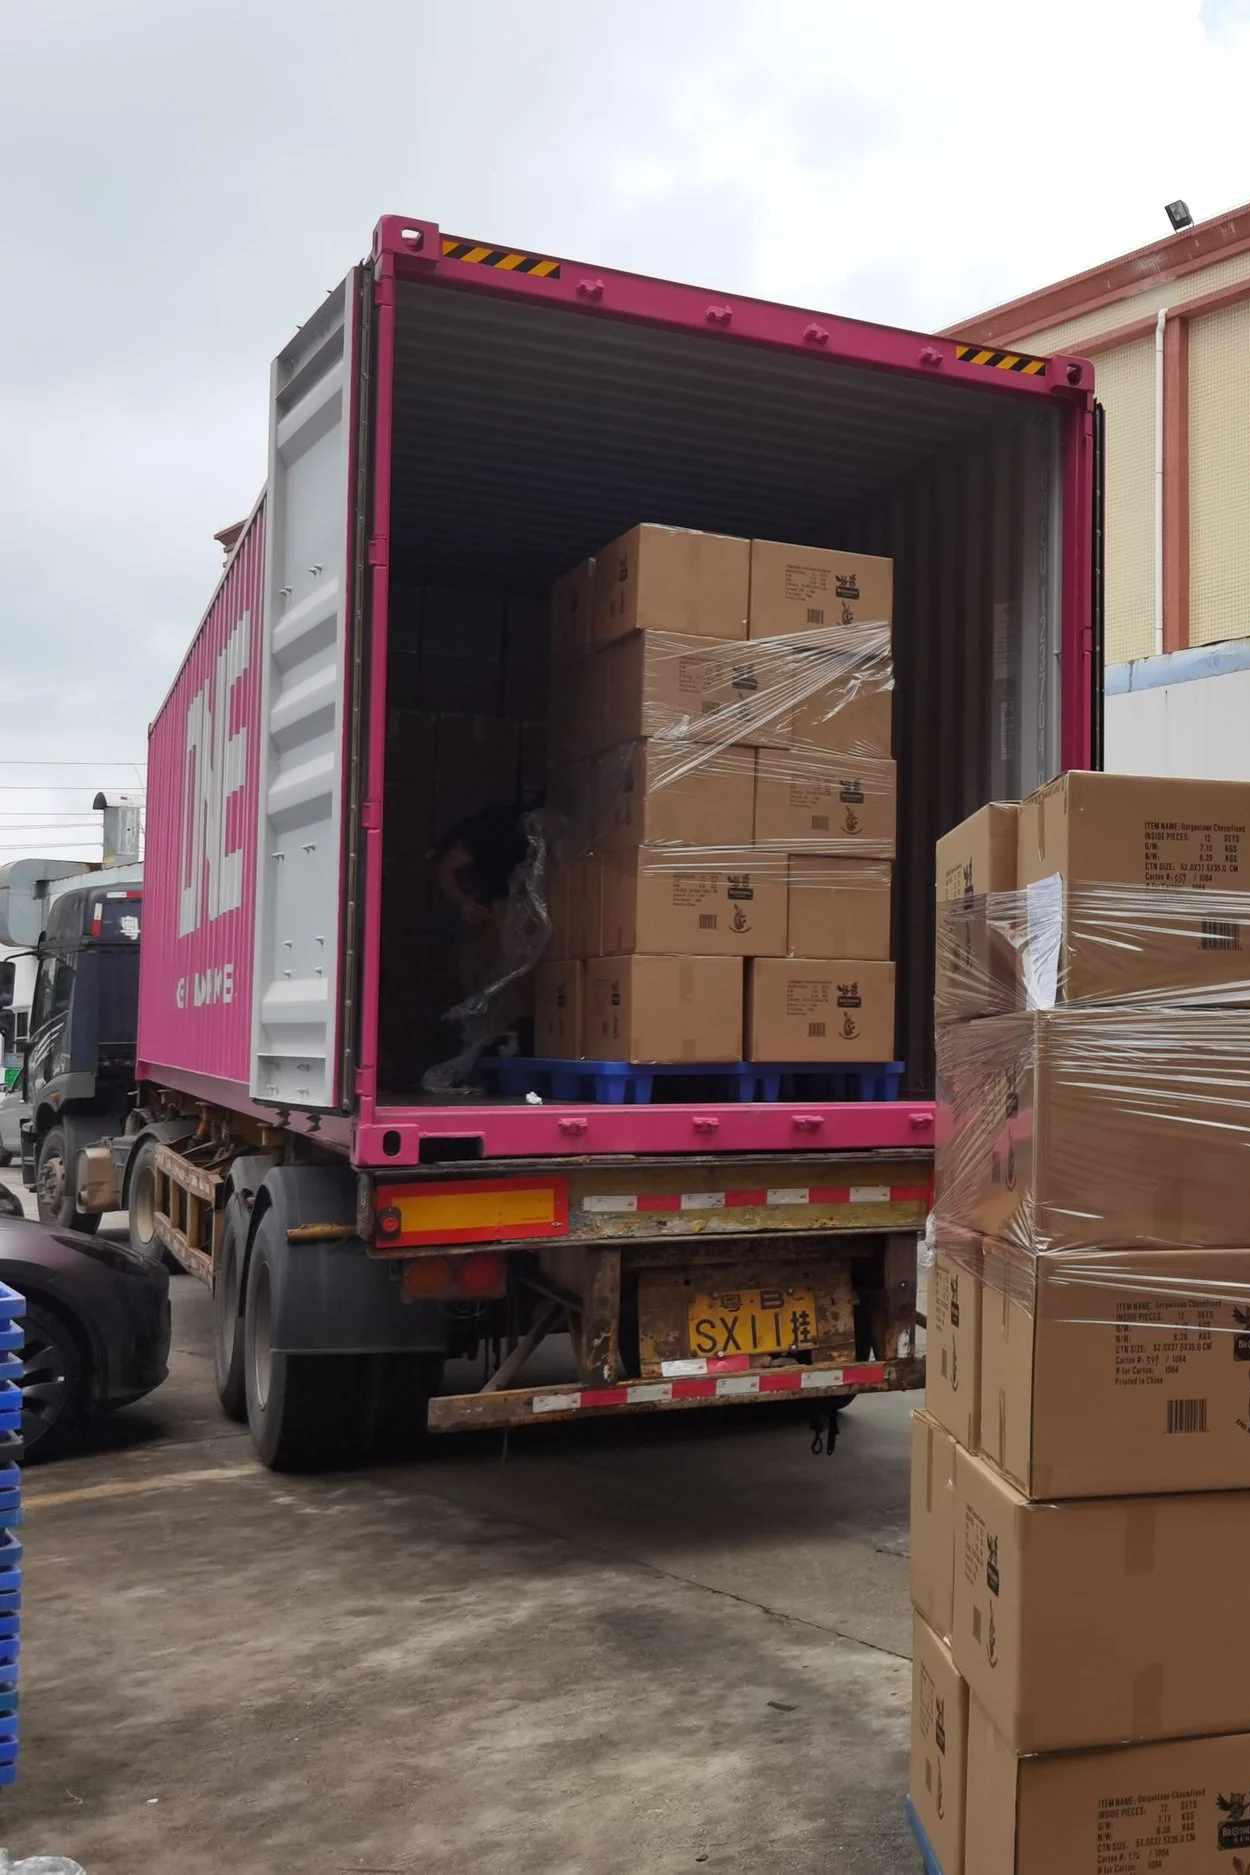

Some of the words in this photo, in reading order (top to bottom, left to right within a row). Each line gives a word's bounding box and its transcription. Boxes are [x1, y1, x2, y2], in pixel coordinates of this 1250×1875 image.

[1144, 822, 1160, 831] ITEM
[1144, 832, 1165, 841] INSIDE
[1166, 833, 1191, 842] PIECES:
[1224, 835, 1240, 843] SETS
[1225, 845, 1238, 853] KGS
[1225, 855, 1238, 863] KGS
[1145, 862, 1158, 871] CTN
[1229, 864, 1239, 873] CM
[1145, 872, 1165, 881] Carton
[1116, 1302, 1131, 1311] ITEM
[1198, 1332, 1212, 1341] KGS
[1116, 1345, 1129, 1354] CTN
[1202, 1342, 1213, 1351] CM
[1116, 1356, 1136, 1365] Carton
[1115, 1377, 1138, 1386] Printed
[1146, 1376, 1164, 1385] China
[1098, 1798, 1114, 1809] ITEM
[1098, 1808, 1119, 1819] INSIDE
[1181, 1800, 1197, 1810] SETS
[1182, 1811, 1195, 1821] KGS
[1182, 1822, 1195, 1832] KGS
[1186, 1833, 1195, 1843] CM
[1097, 1854, 1118, 1864] Carton
